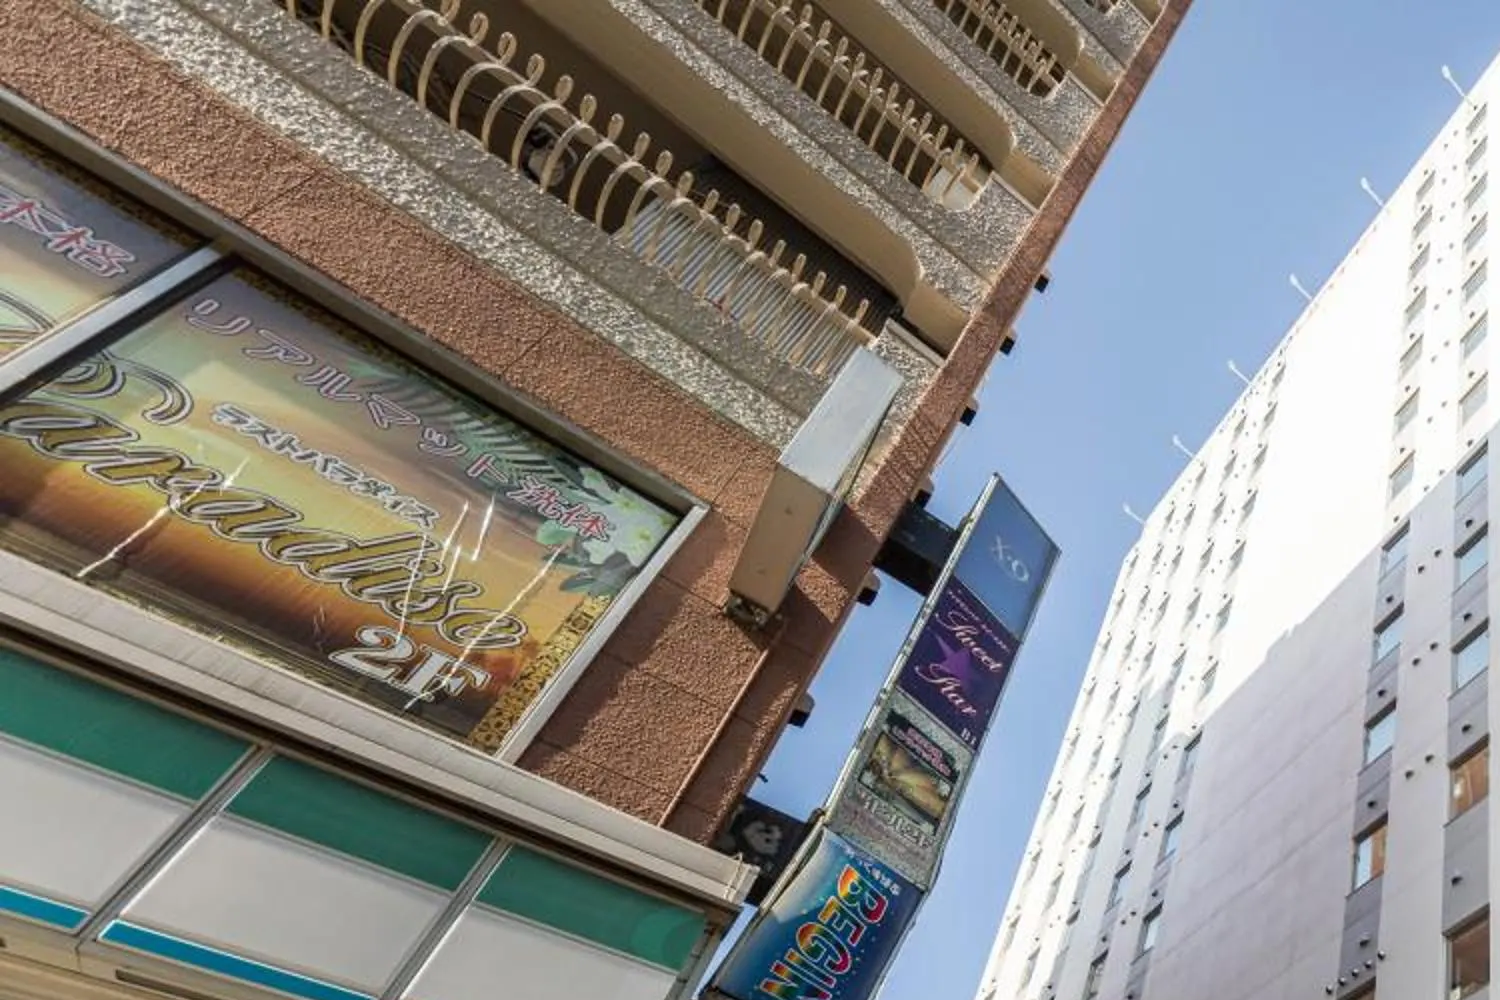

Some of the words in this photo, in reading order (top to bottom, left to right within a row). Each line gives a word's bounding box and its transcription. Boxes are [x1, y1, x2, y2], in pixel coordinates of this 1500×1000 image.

[183, 298, 610, 541] リアルマット洗体
[210, 402, 441, 530] ラストパラダイス
[328, 623, 491, 700] 2F
[934, 610, 1004, 673] Sweet
[914, 663, 978, 716] Star
